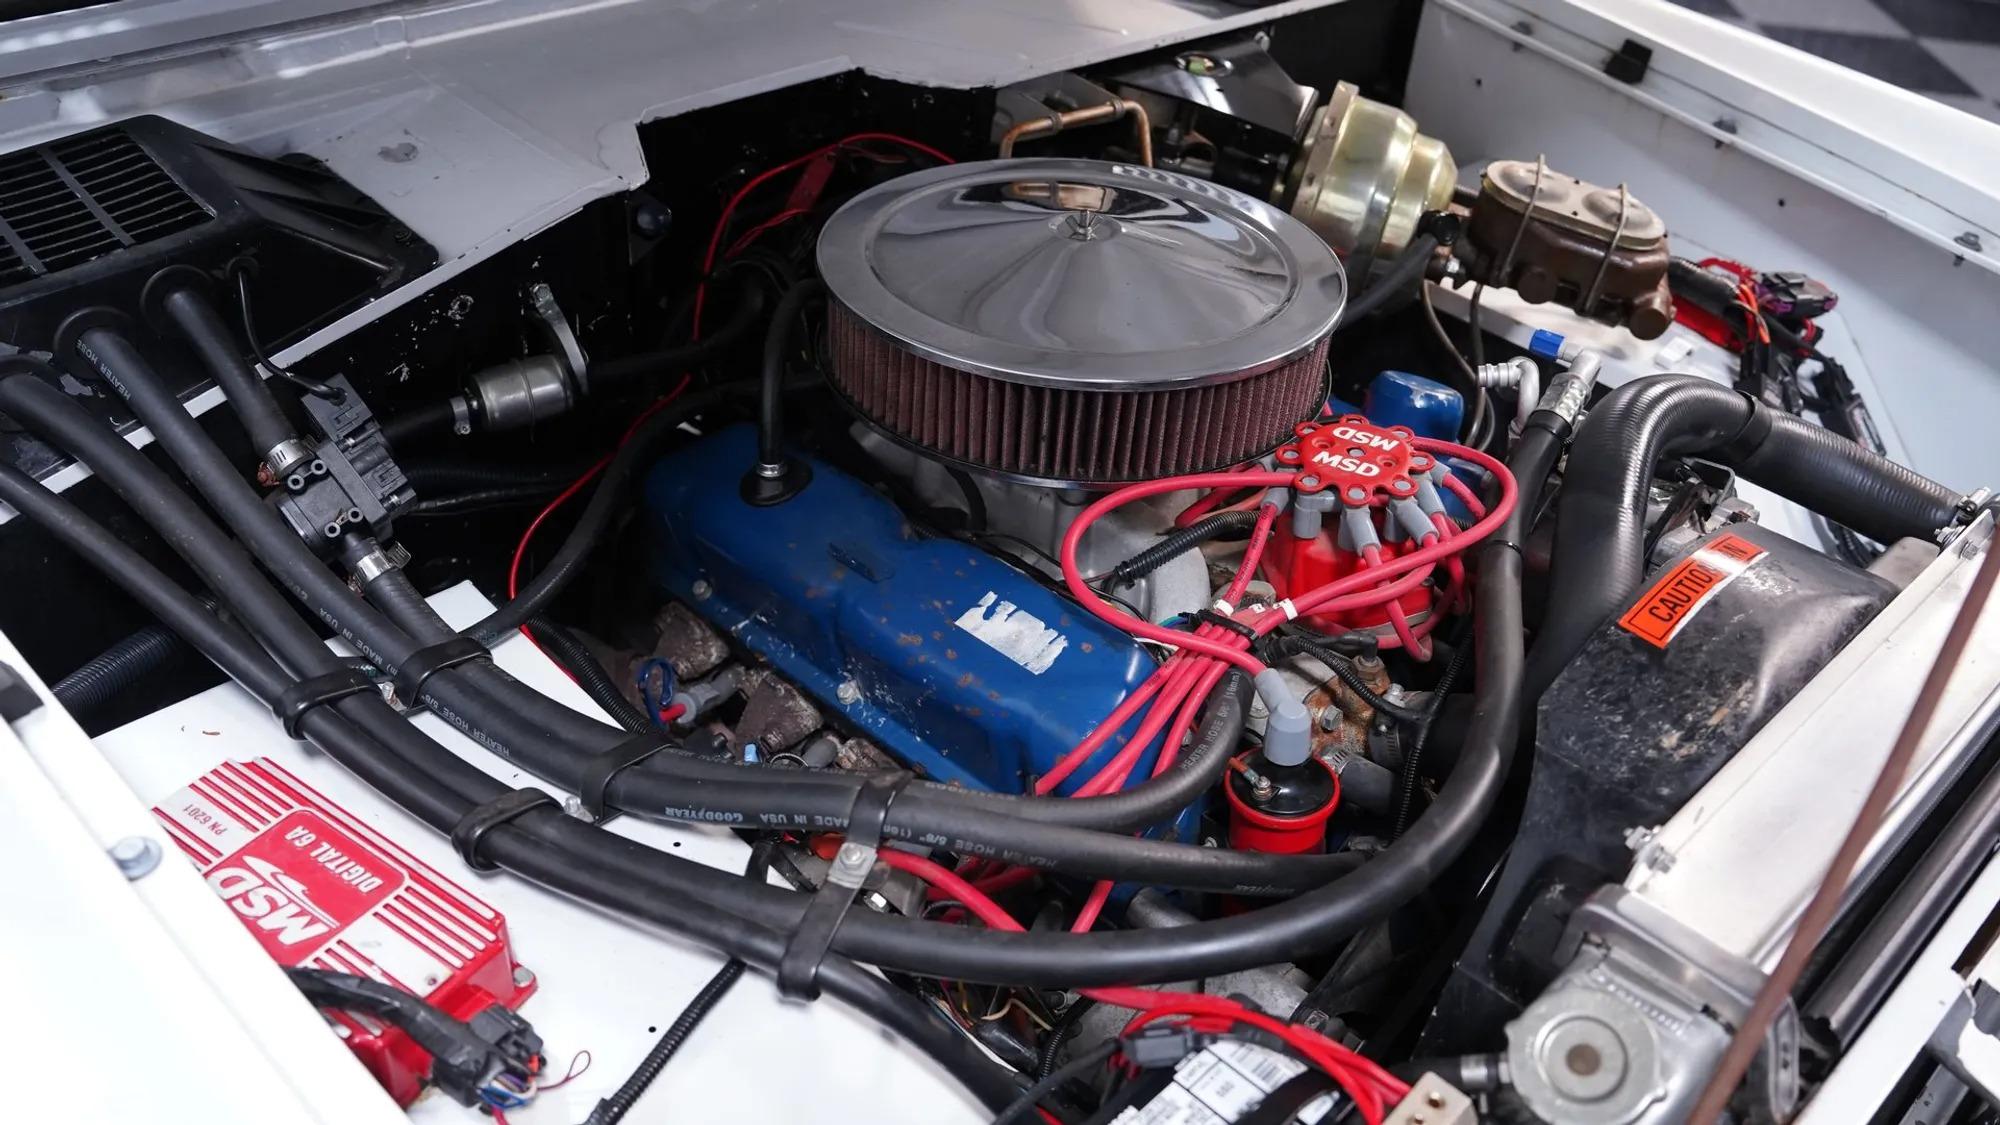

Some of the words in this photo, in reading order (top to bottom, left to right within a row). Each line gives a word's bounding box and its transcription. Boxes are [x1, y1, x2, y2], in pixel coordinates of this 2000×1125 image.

[77, 339, 98, 364] HOSE
[101, 363, 131, 400] HEATER
[1333, 426, 1399, 451] MSD
[1312, 451, 1380, 477] MSD
[320, 608, 338, 628] USA
[342, 628, 353, 639] IN
[356, 639, 383, 664] MADE
[443, 707, 468, 731] HOSE
[1205, 717, 1224, 743] HOSE
[473, 727, 509, 756] HEATER
[183, 804, 212, 824] 6201
[665, 806, 743, 823] GOODYEAR
[760, 813, 787, 824] USA
[794, 815, 807, 825] IN
[208, 821, 228, 835] PN
[284, 826, 312, 848] 6A
[955, 840, 996, 856] HOSE
[310, 841, 384, 894] DIGITAL
[206, 866, 329, 945] MSD
